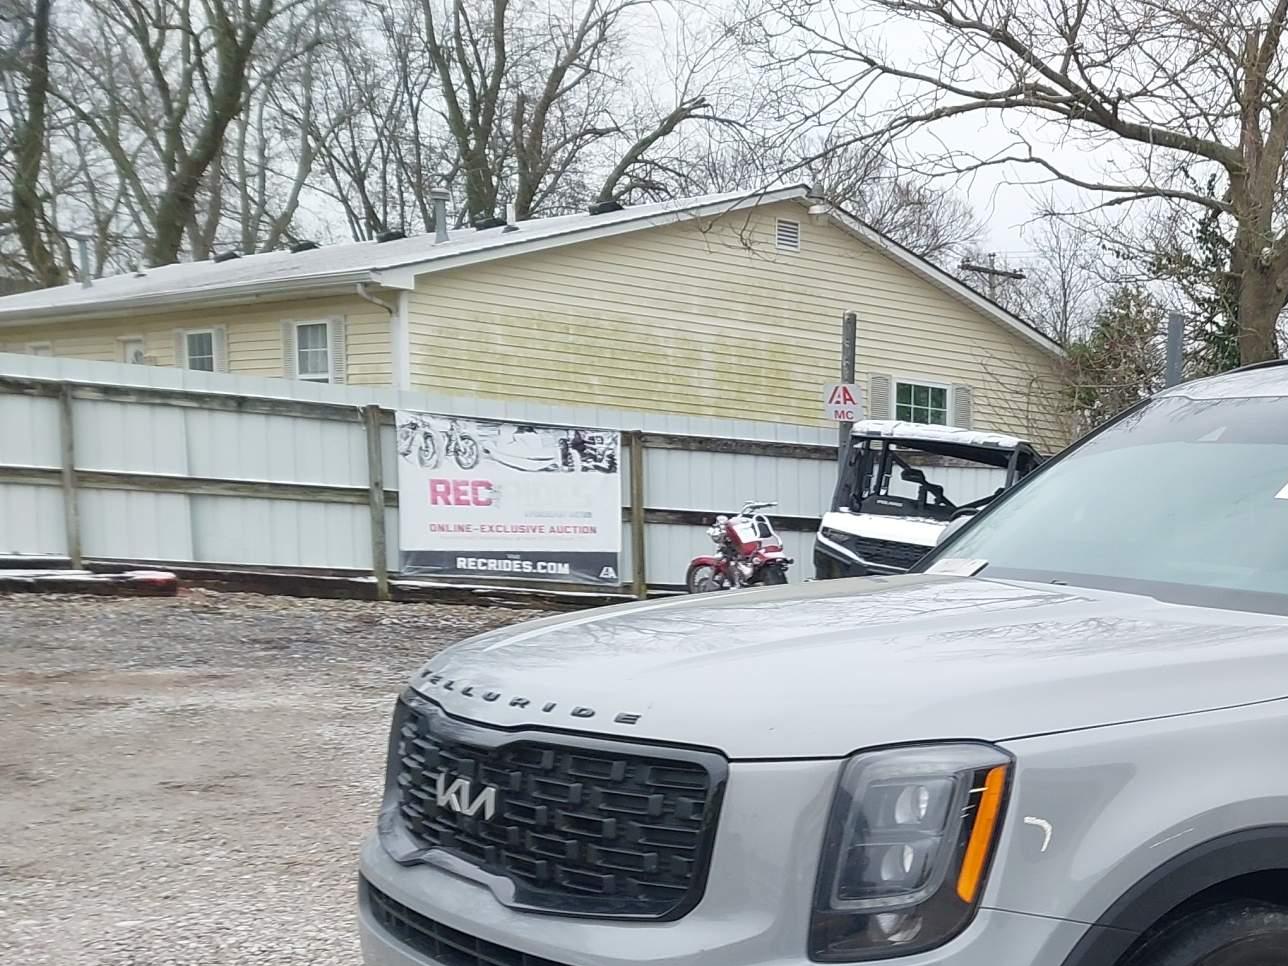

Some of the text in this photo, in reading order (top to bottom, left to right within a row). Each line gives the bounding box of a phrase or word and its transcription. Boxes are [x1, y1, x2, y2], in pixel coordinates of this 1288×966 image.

[834, 410, 854, 420] MC
[429, 523, 597, 534] ONLINE-EXCLUSIVE AUCTION
[457, 557, 570, 575] RECRIDES.COM
